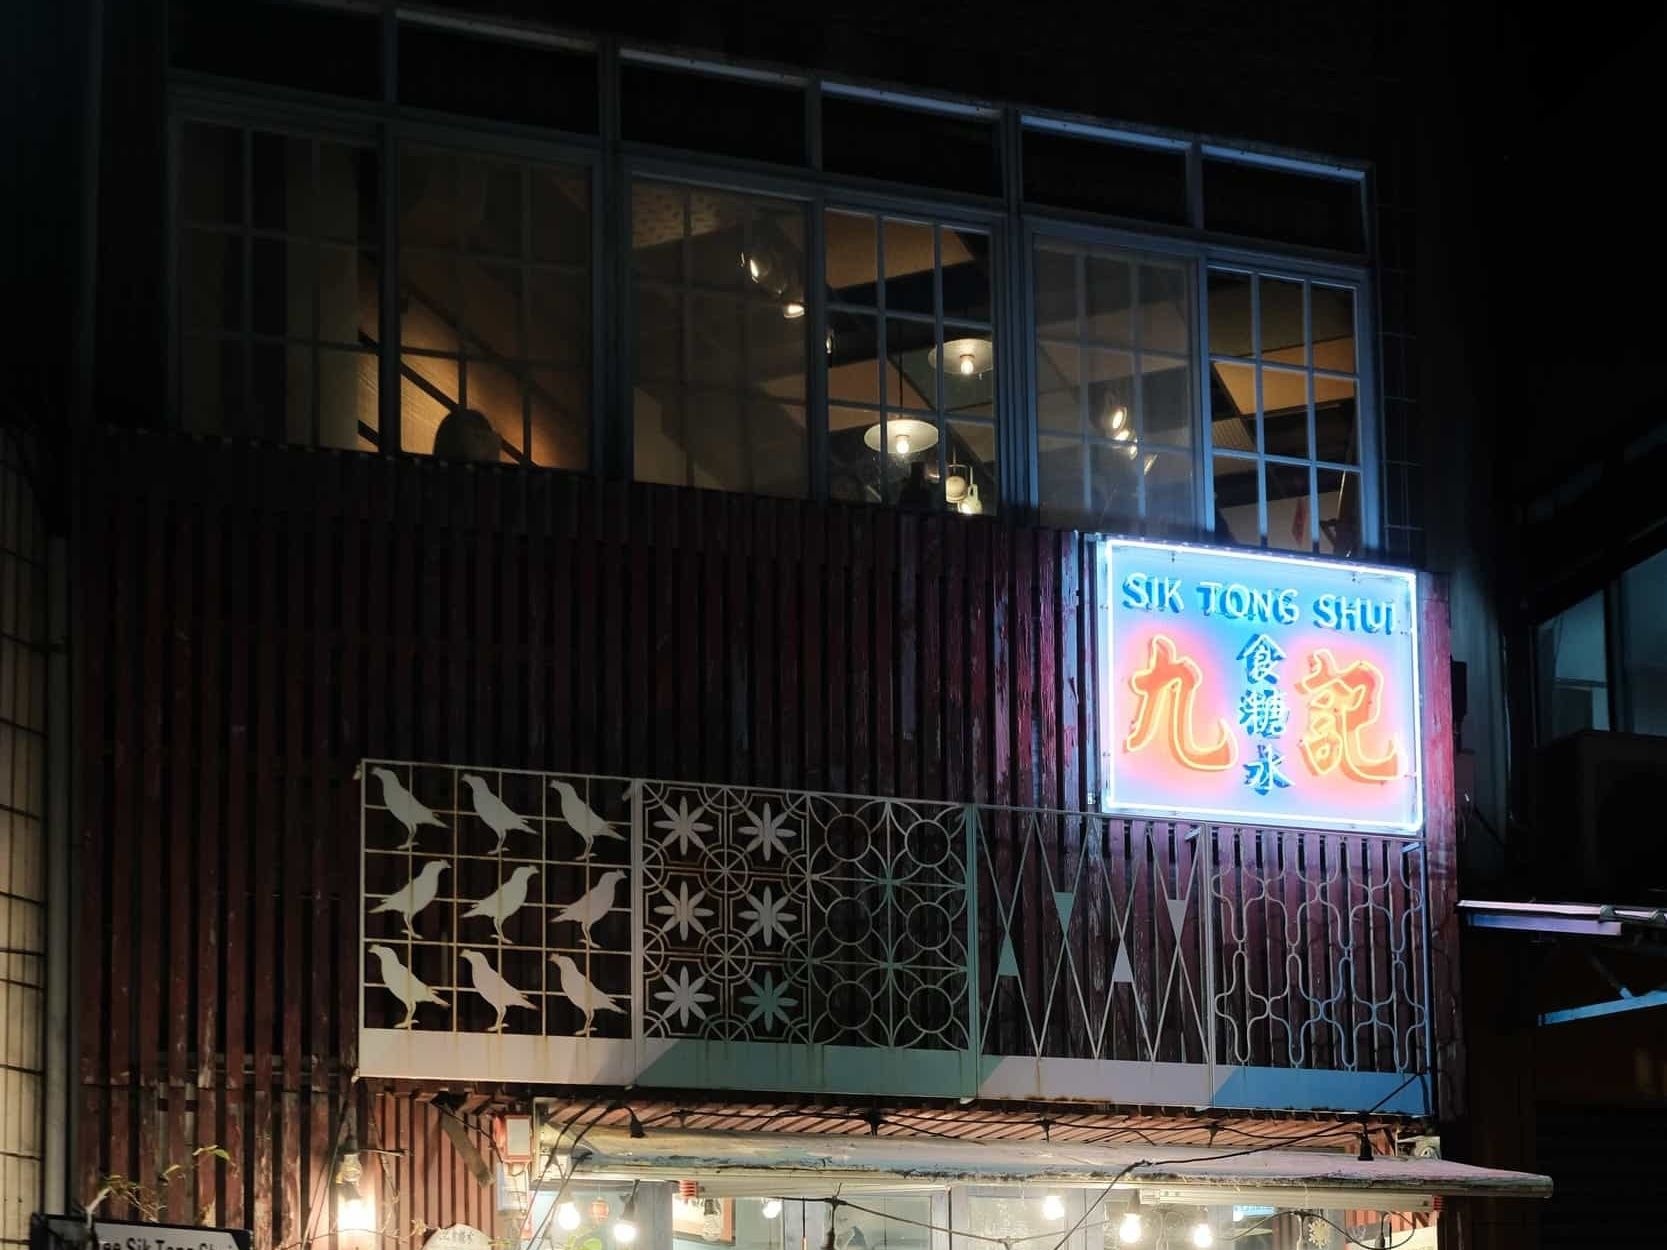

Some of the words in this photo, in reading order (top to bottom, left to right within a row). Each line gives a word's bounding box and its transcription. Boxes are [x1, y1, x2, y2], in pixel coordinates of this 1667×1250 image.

[1122, 572, 1184, 614] SIK
[1197, 581, 1300, 625] TONG
[1313, 593, 1398, 635] SHUI
[1123, 634, 1239, 771] 九
[1236, 633, 1295, 796] 食糖水
[1296, 649, 1401, 784] 記
